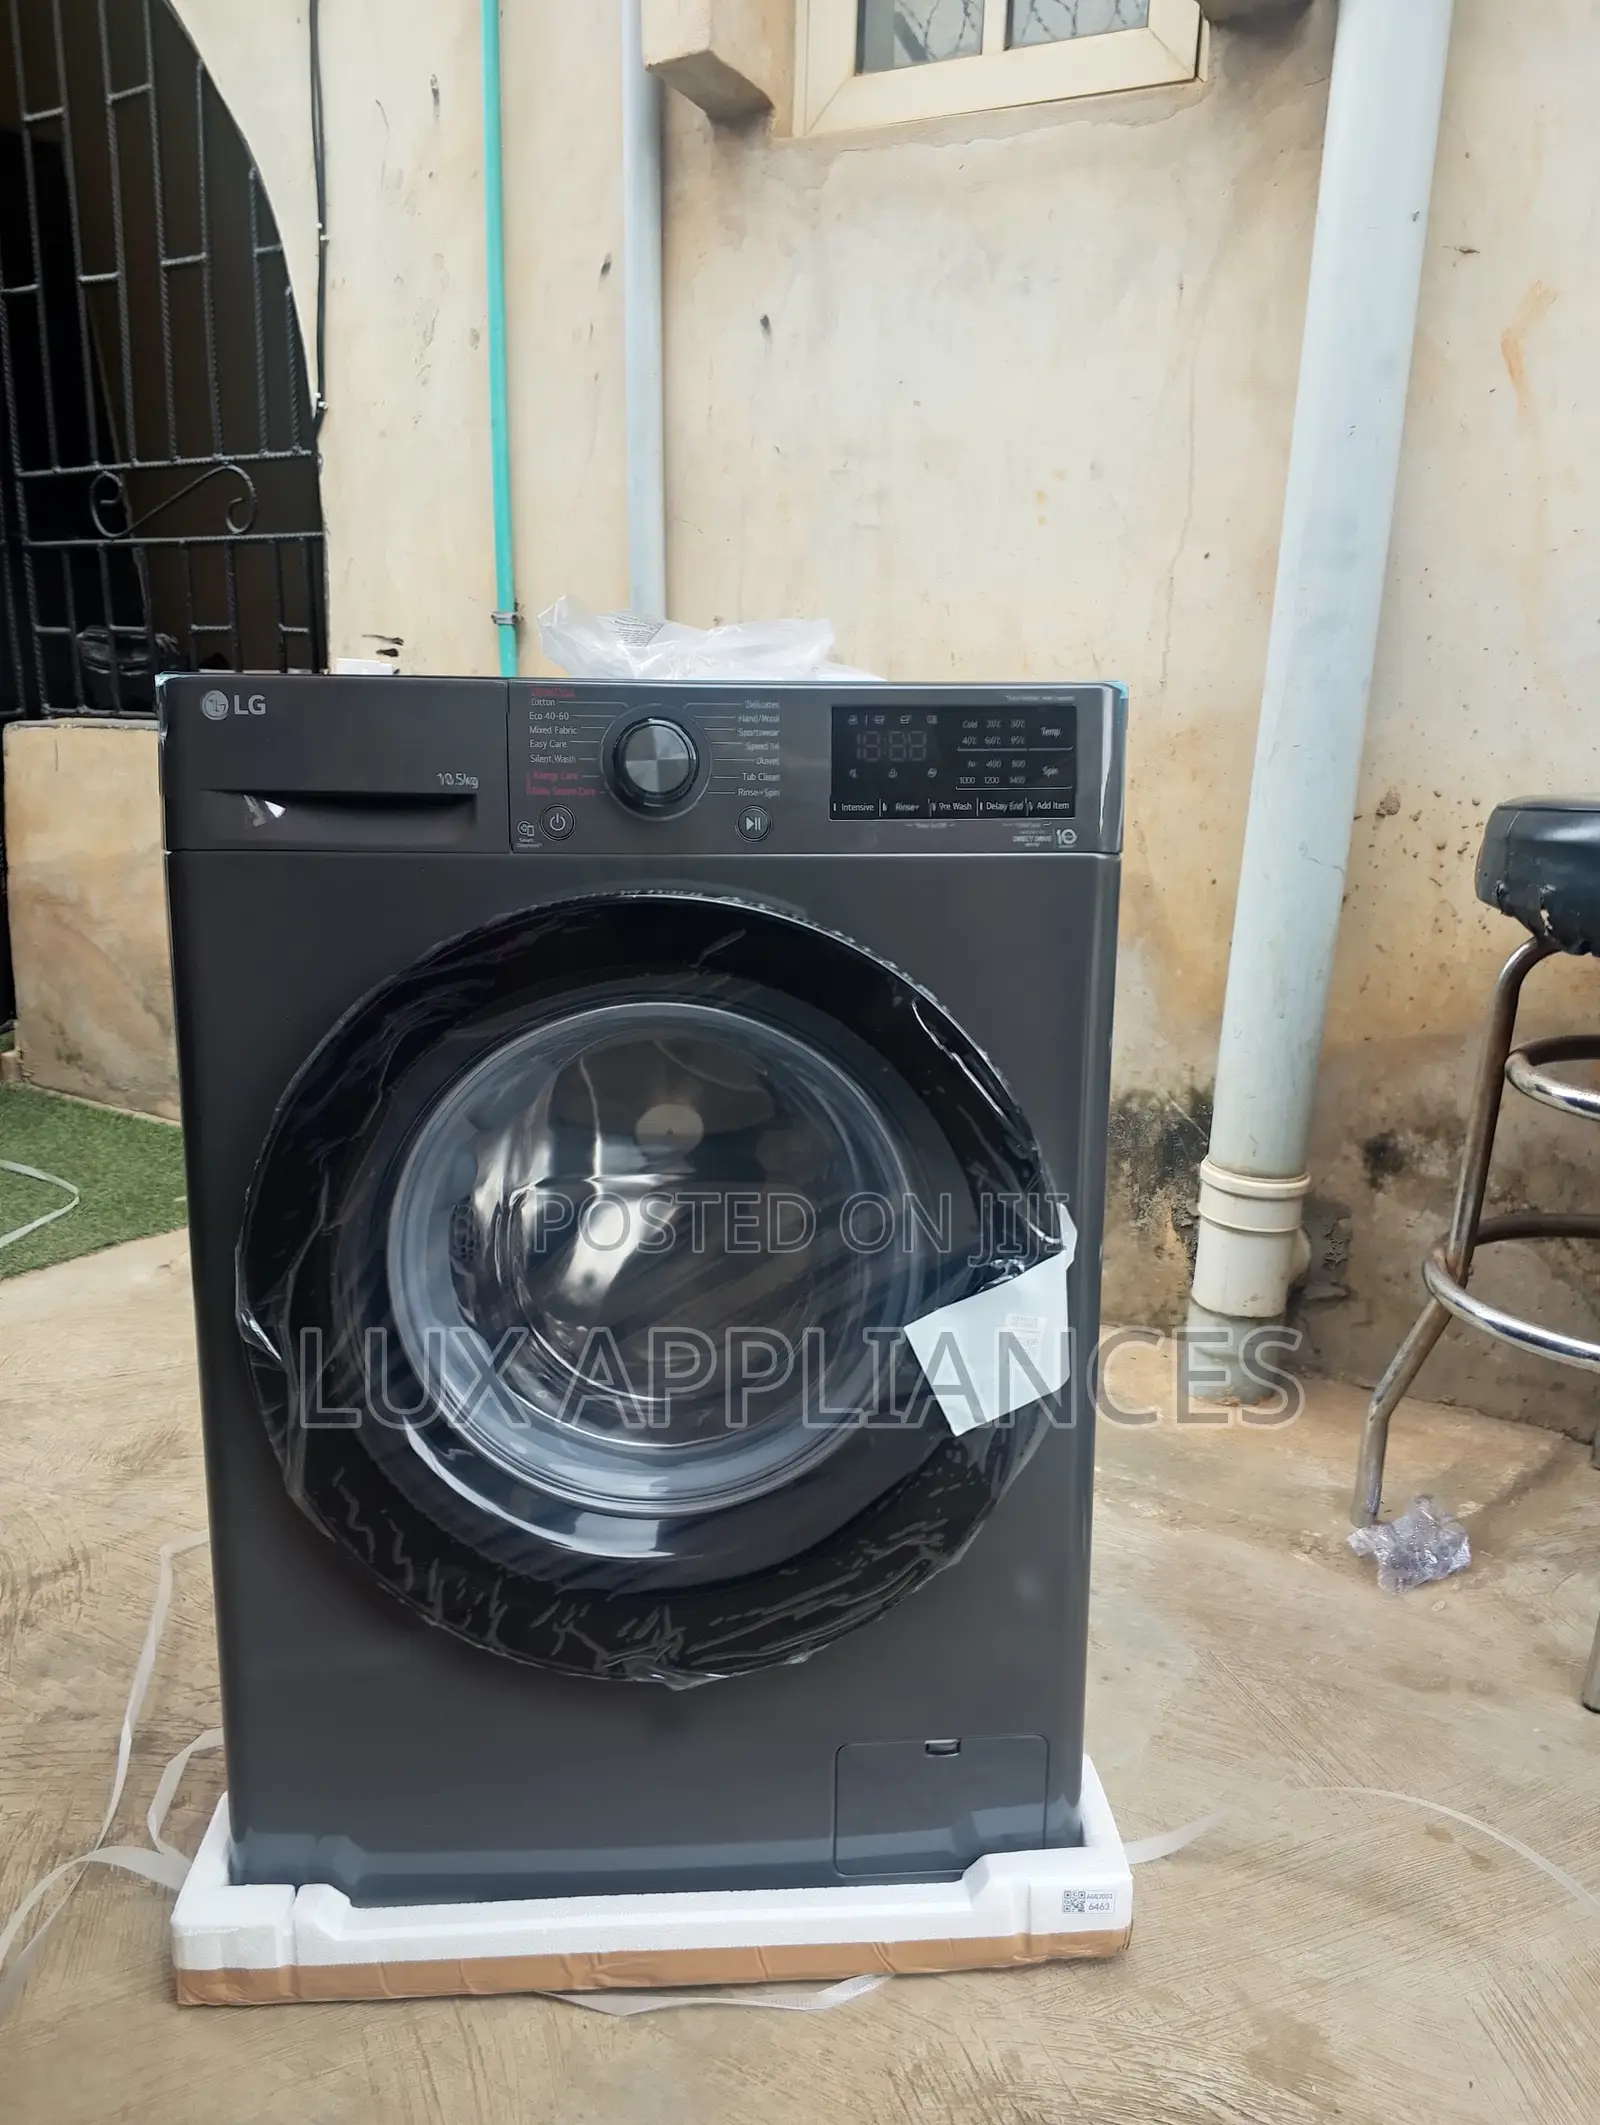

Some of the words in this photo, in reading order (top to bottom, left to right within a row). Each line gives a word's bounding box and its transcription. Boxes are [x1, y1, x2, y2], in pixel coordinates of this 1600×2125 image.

[234, 694, 266, 715] LG
[529, 712, 543, 720] Eco
[544, 712, 569, 720] 40-60
[554, 726, 578, 735] Fabric
[529, 740, 547, 749] Easy
[549, 740, 568, 748] Care
[742, 772, 757, 781] Tub
[959, 776, 975, 784] 1000
[984, 776, 1000, 784] 1200
[841, 802, 875, 811] Intensive
[952, 802, 972, 810] Wash
[986, 802, 1008, 812] Delay
[1009, 802, 1024, 810] End
[1037, 801, 1051, 810] Add
[1052, 801, 1070, 810] Item
[1088, 1902, 1110, 1911] 6463
